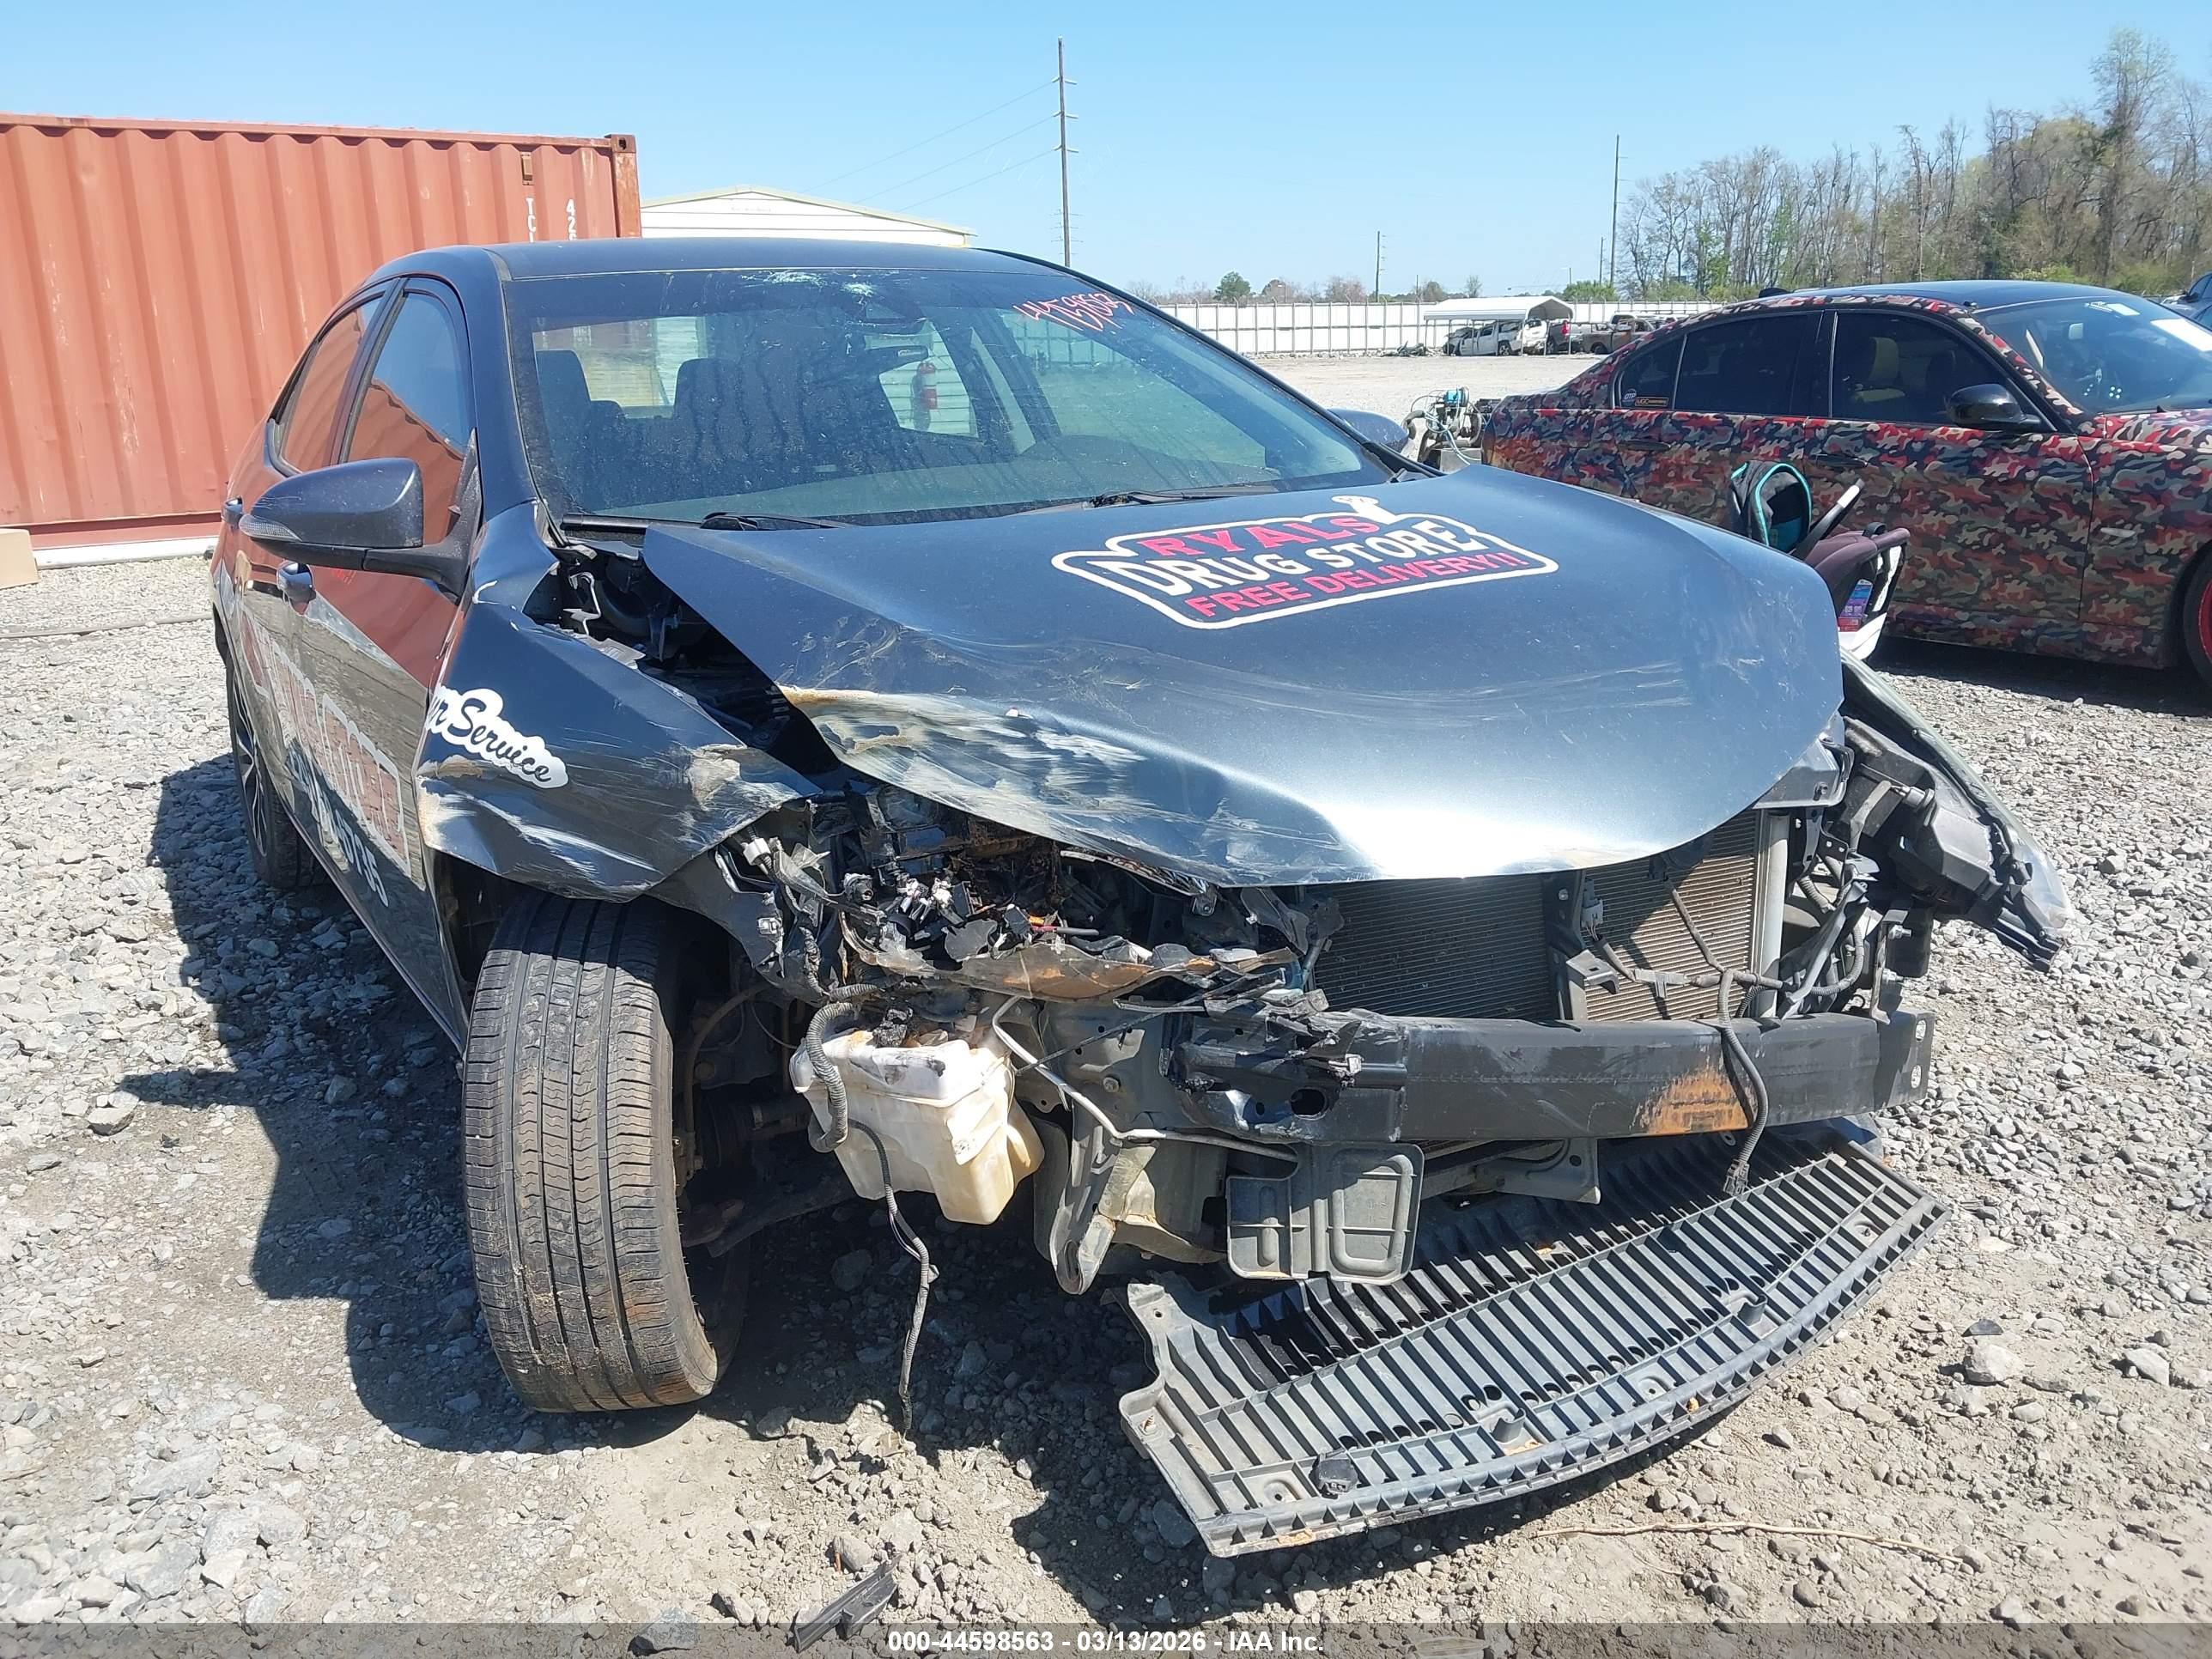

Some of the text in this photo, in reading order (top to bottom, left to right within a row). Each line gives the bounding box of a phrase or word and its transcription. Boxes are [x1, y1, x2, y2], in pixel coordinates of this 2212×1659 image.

[1085, 520, 1489, 596] DRUG STORE
[1135, 517, 1380, 556] RYALS
[1184, 552, 1529, 617] FREE DELIVERY!!
[447, 697, 552, 782] Service
